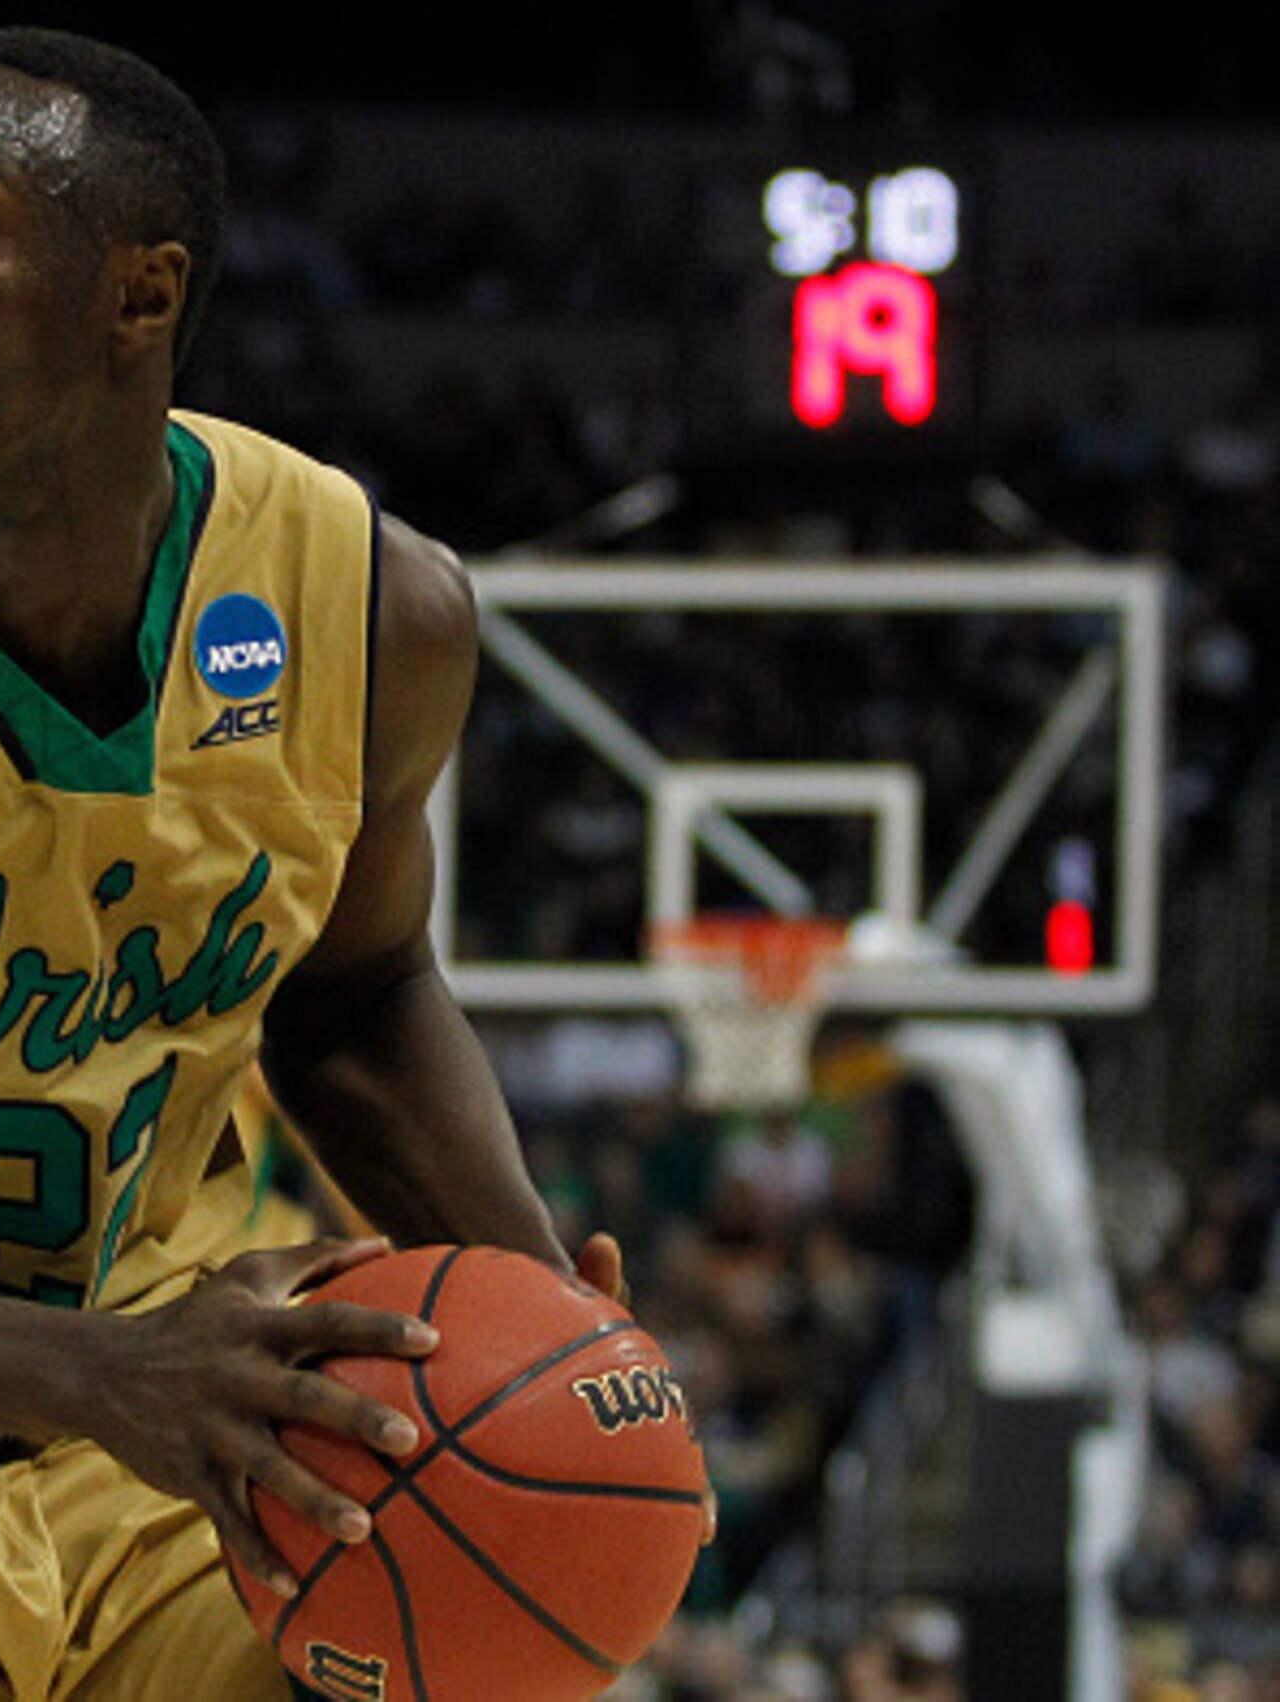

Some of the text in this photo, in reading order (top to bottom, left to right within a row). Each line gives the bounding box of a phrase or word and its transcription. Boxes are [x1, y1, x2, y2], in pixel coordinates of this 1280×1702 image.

[792, 261, 937, 429] 19
[207, 638, 282, 674] NCAA
[190, 698, 280, 752] ACC
